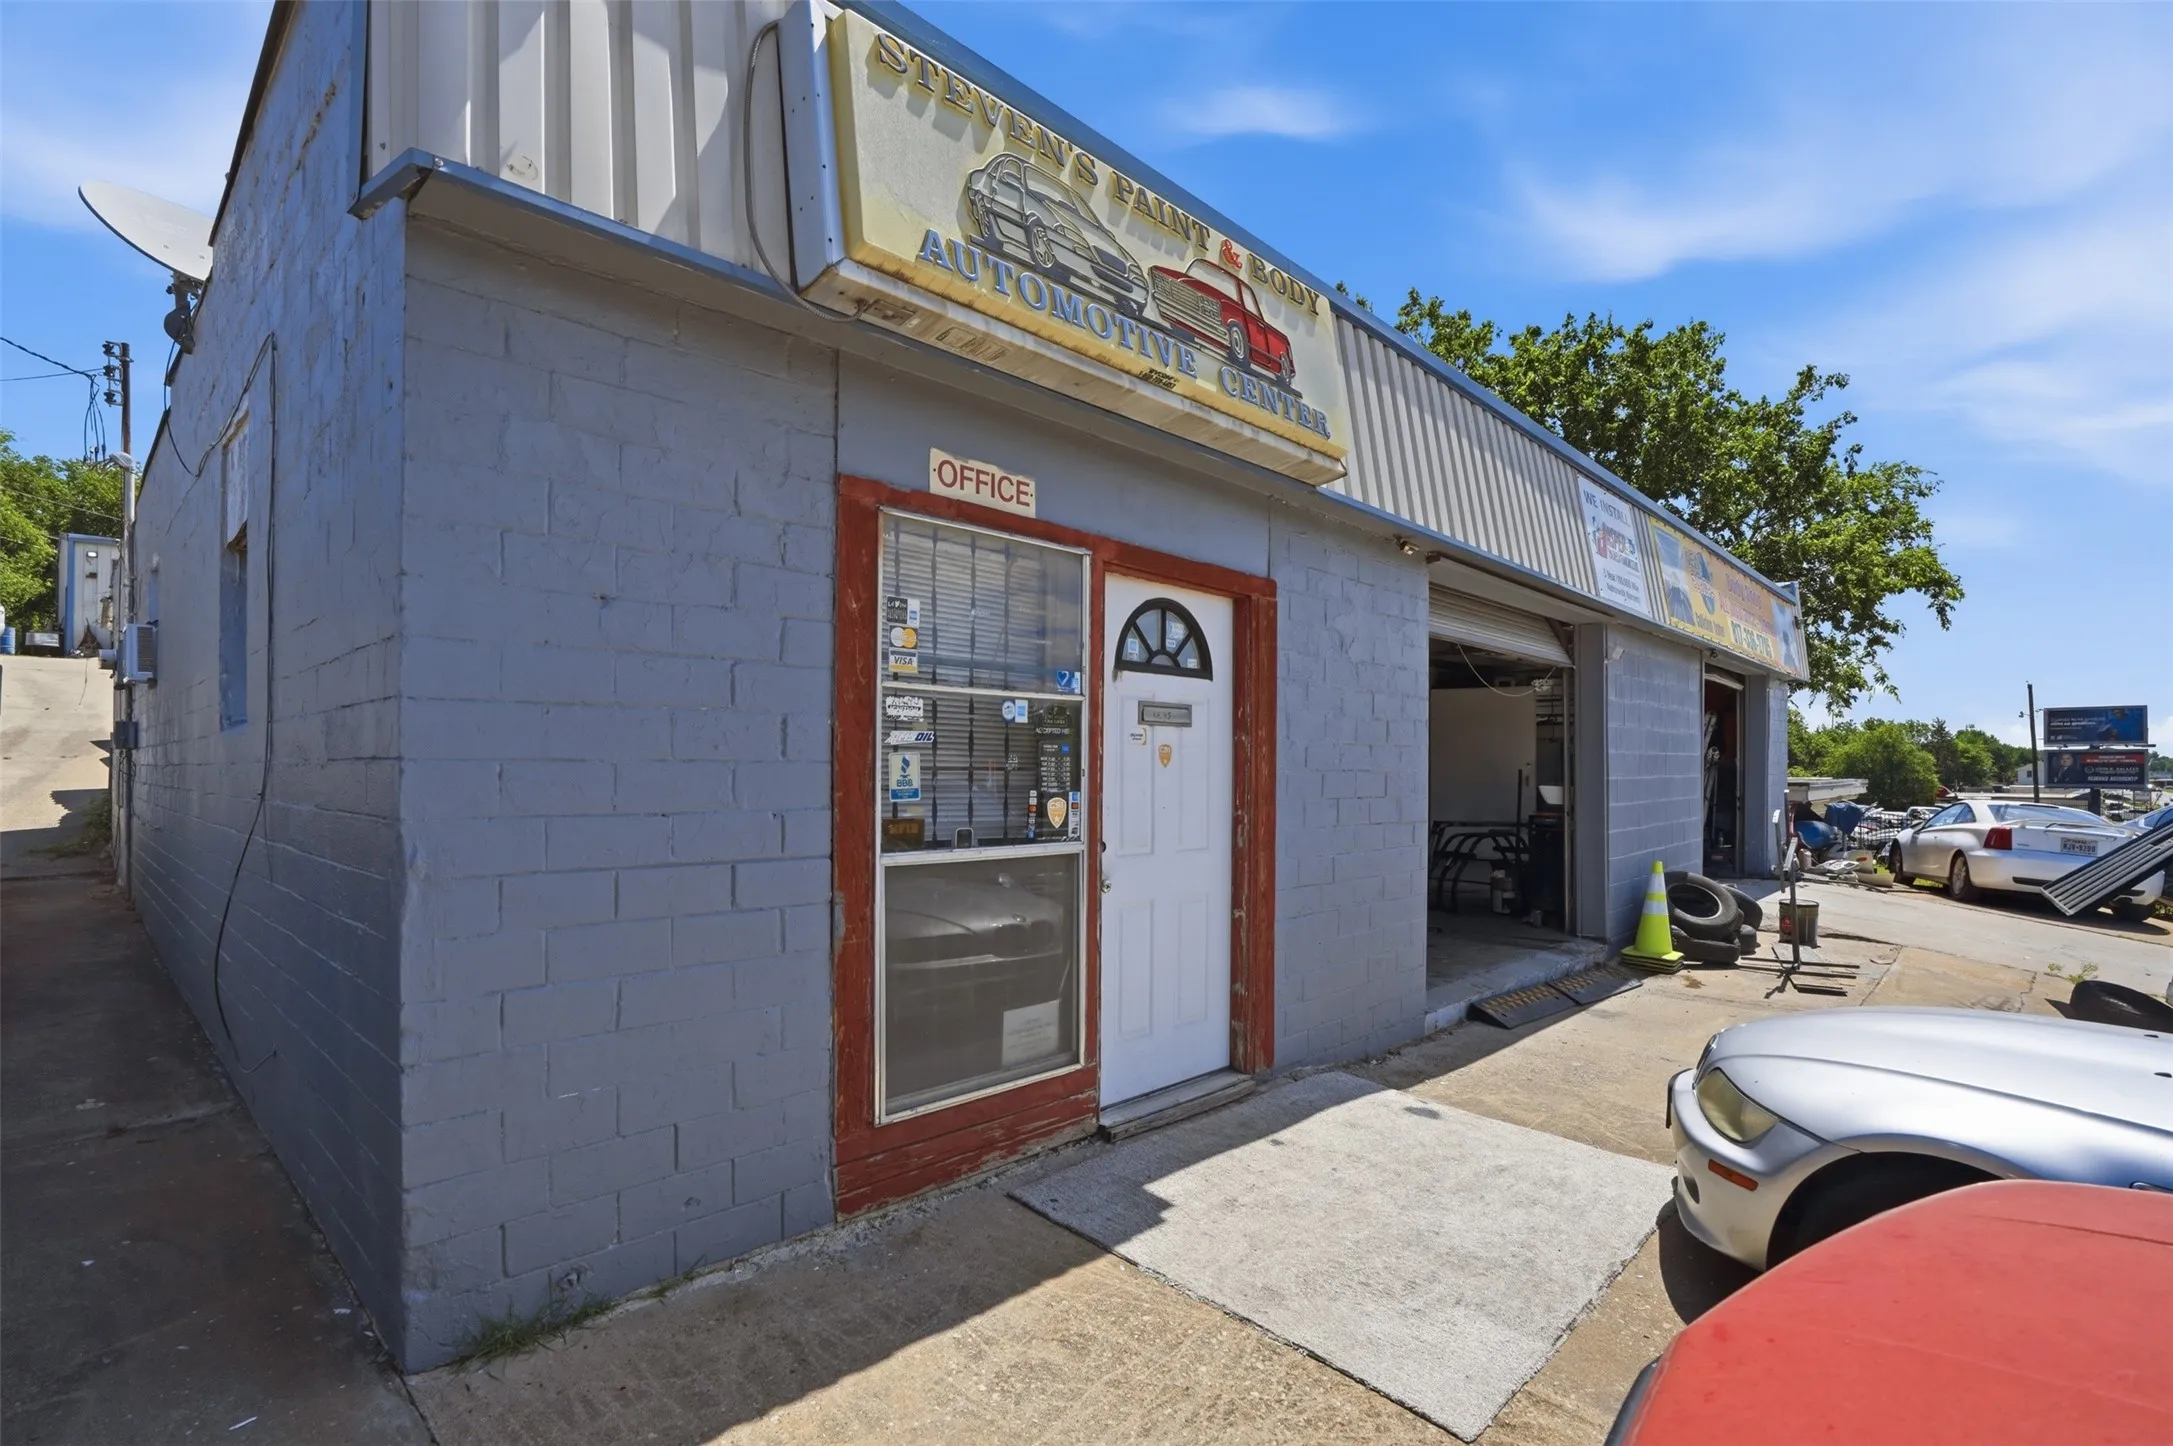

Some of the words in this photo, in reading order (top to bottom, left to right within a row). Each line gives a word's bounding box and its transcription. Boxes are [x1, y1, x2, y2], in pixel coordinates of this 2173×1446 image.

[877, 32, 1098, 186] STEVEN'S
[1110, 170, 1210, 252] PAINT
[1219, 238, 1243, 270] &
[1248, 252, 1320, 316] BODY
[919, 228, 1199, 379] AUTOMOTIVE
[1220, 366, 1332, 440] CENTER
[937, 459, 1031, 507] OFFICE
[1583, 489, 1599, 509] WE
[1599, 499, 1631, 528] INSTALL
[894, 656, 913, 666] VISA
[896, 779, 913, 788] BBB
